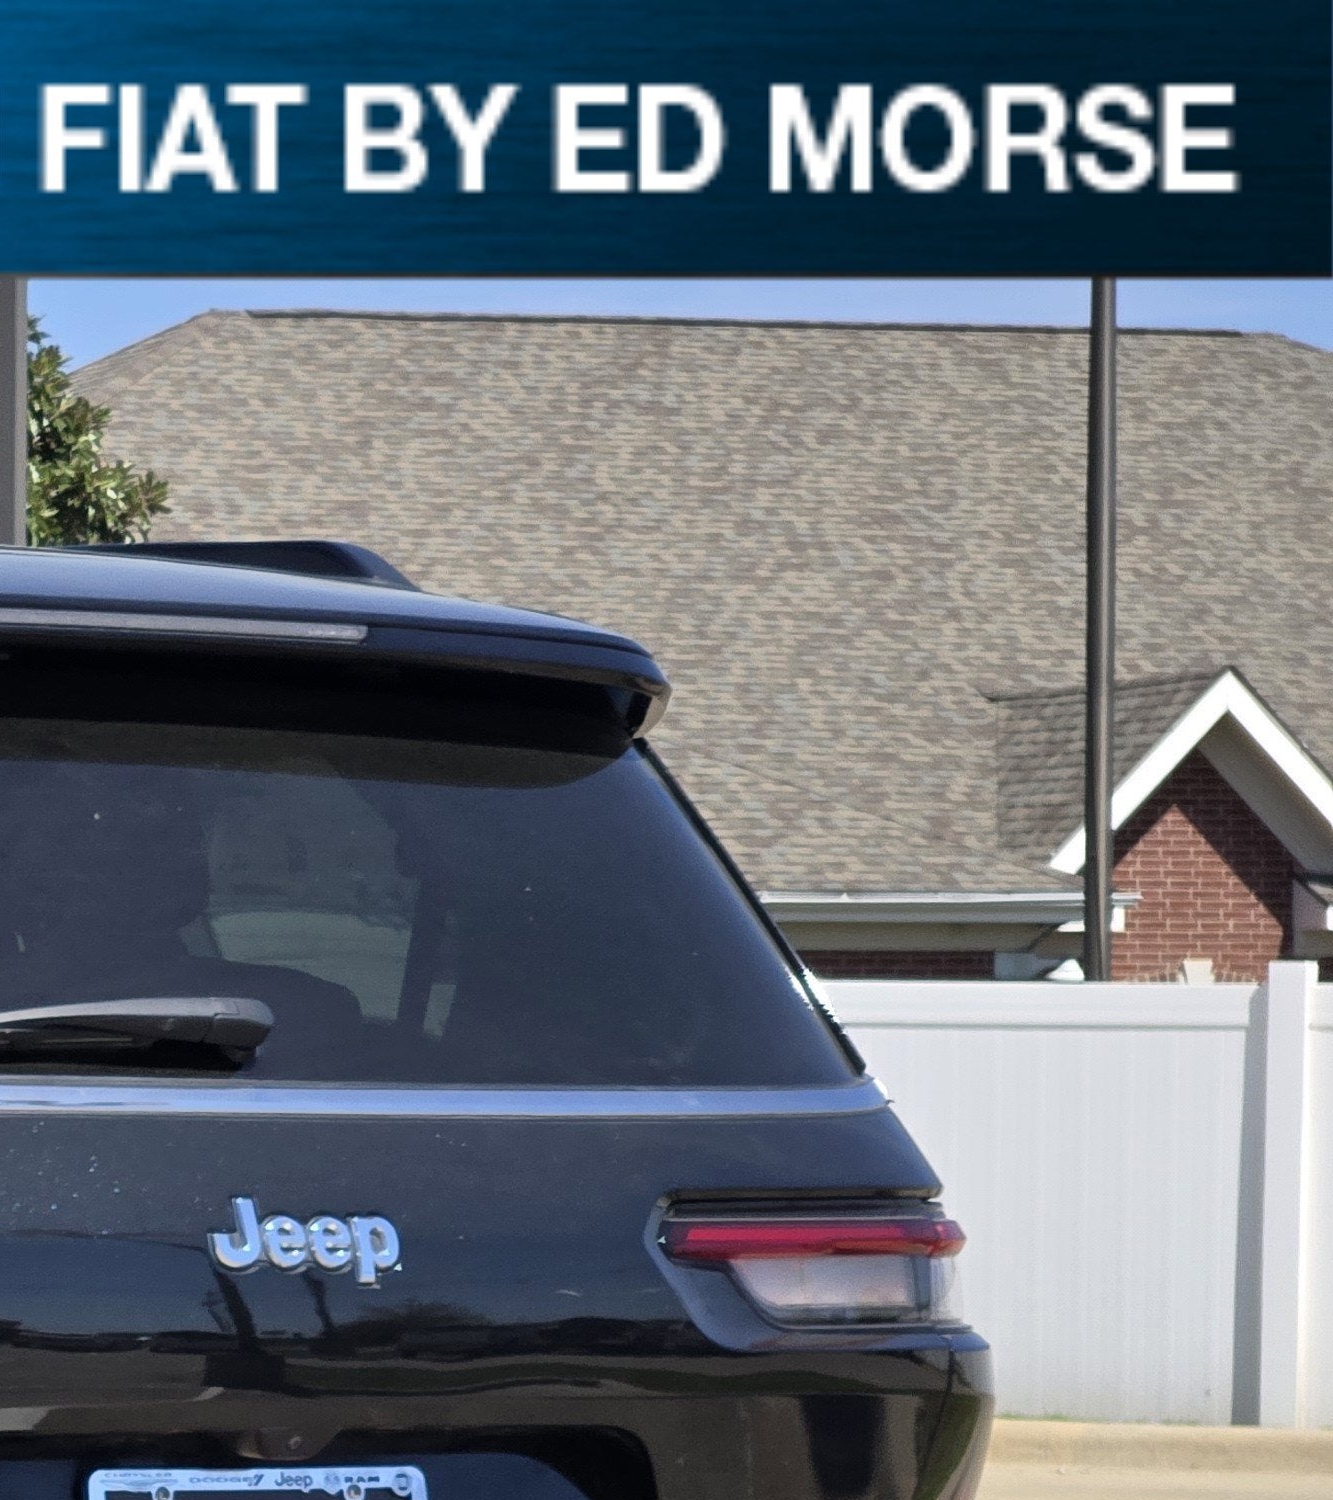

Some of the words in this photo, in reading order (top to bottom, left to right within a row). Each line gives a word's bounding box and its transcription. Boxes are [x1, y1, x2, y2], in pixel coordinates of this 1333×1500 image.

[208, 1196, 401, 1286] Jeep
[274, 1471, 314, 1488] Jeep
[344, 1475, 380, 1483] RAM
